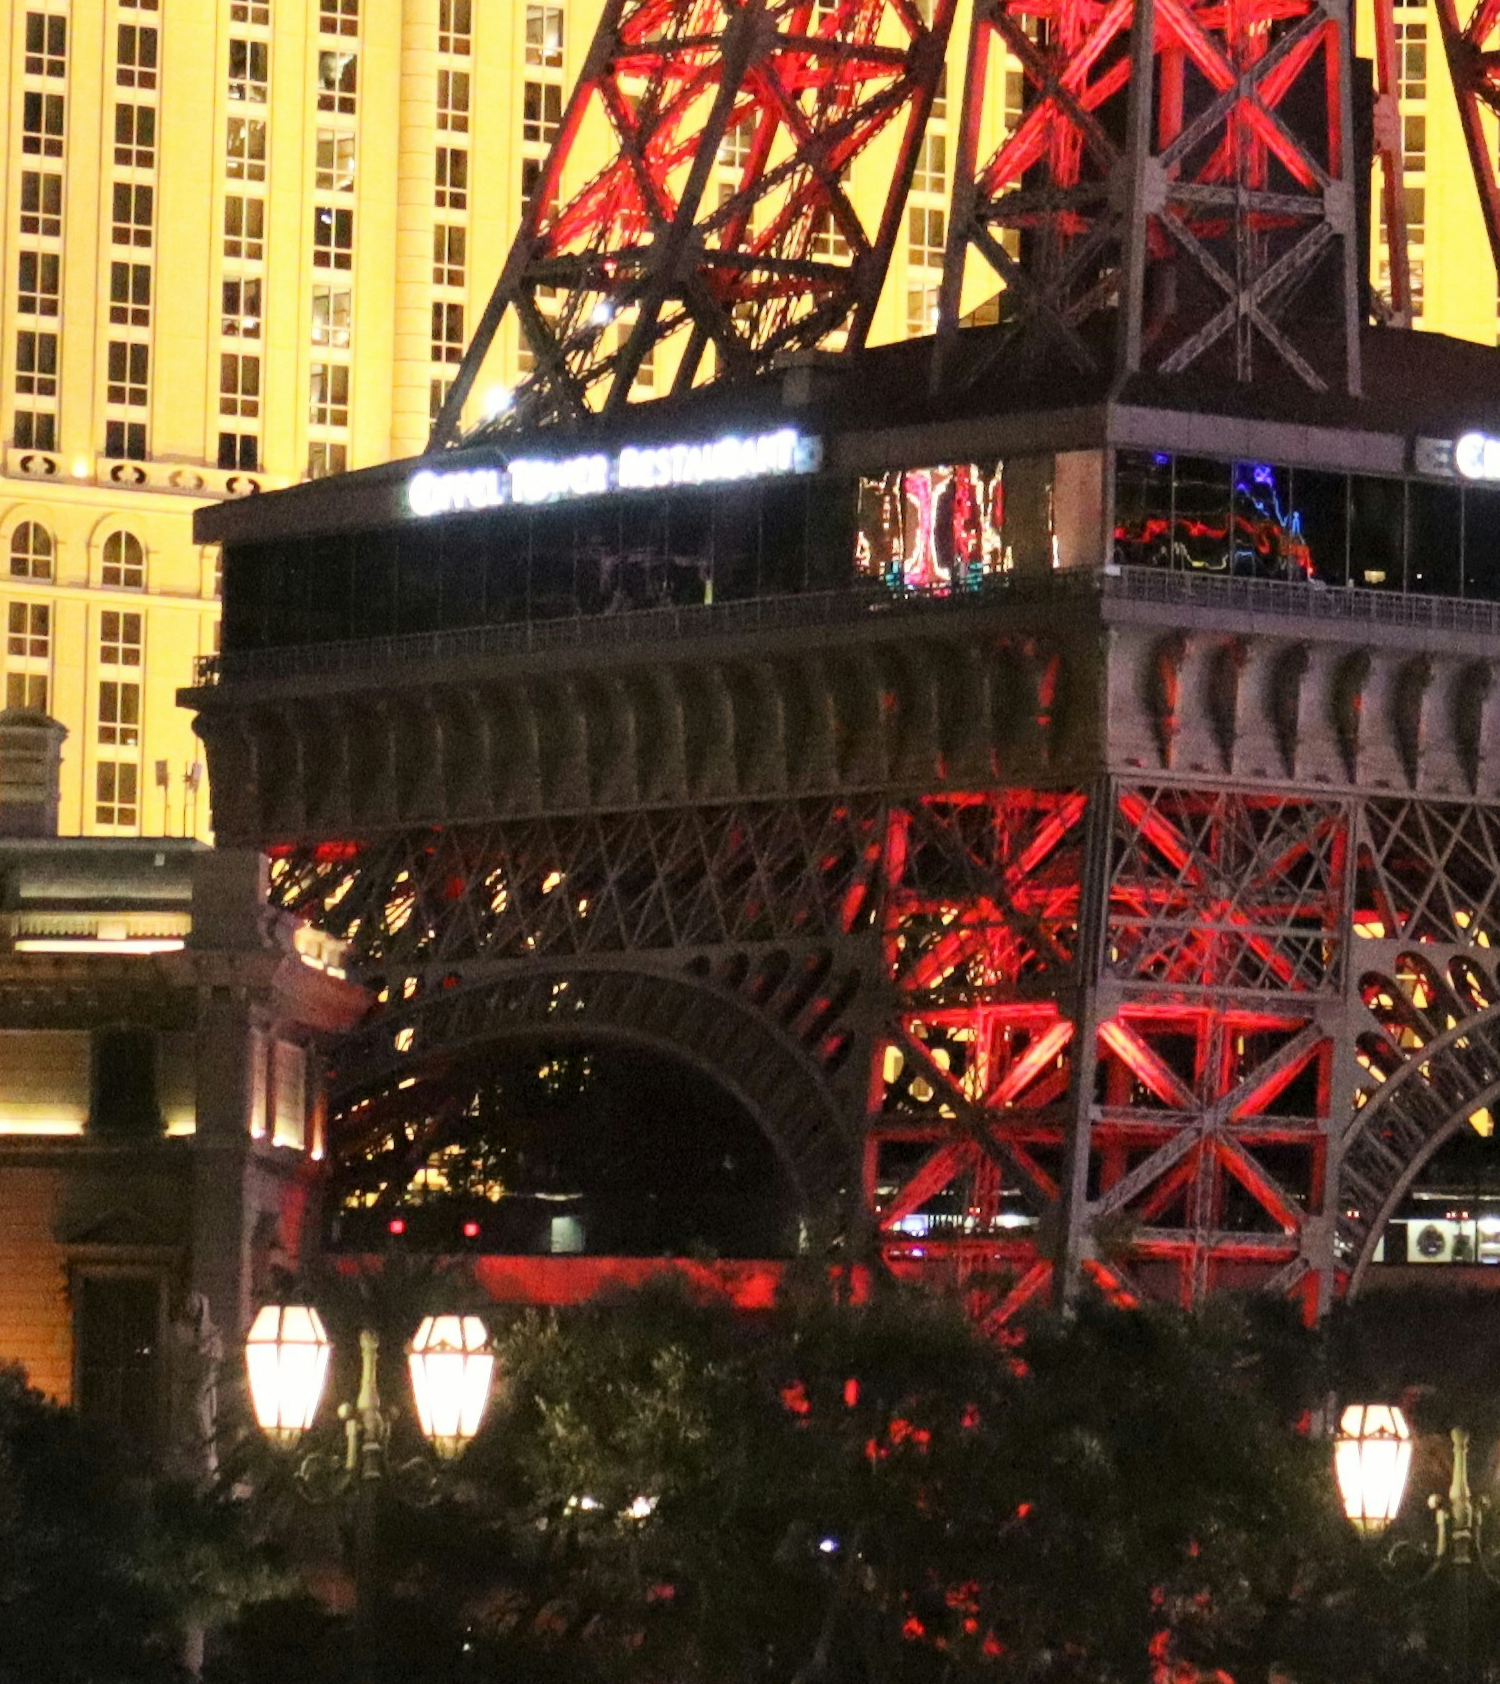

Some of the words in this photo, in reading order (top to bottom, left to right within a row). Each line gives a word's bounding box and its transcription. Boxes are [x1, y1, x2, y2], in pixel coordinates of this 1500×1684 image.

[409, 470, 503, 516] EIFFEL
[508, 455, 607, 503] TOWER
[618, 429, 796, 488] RESTAURANT
